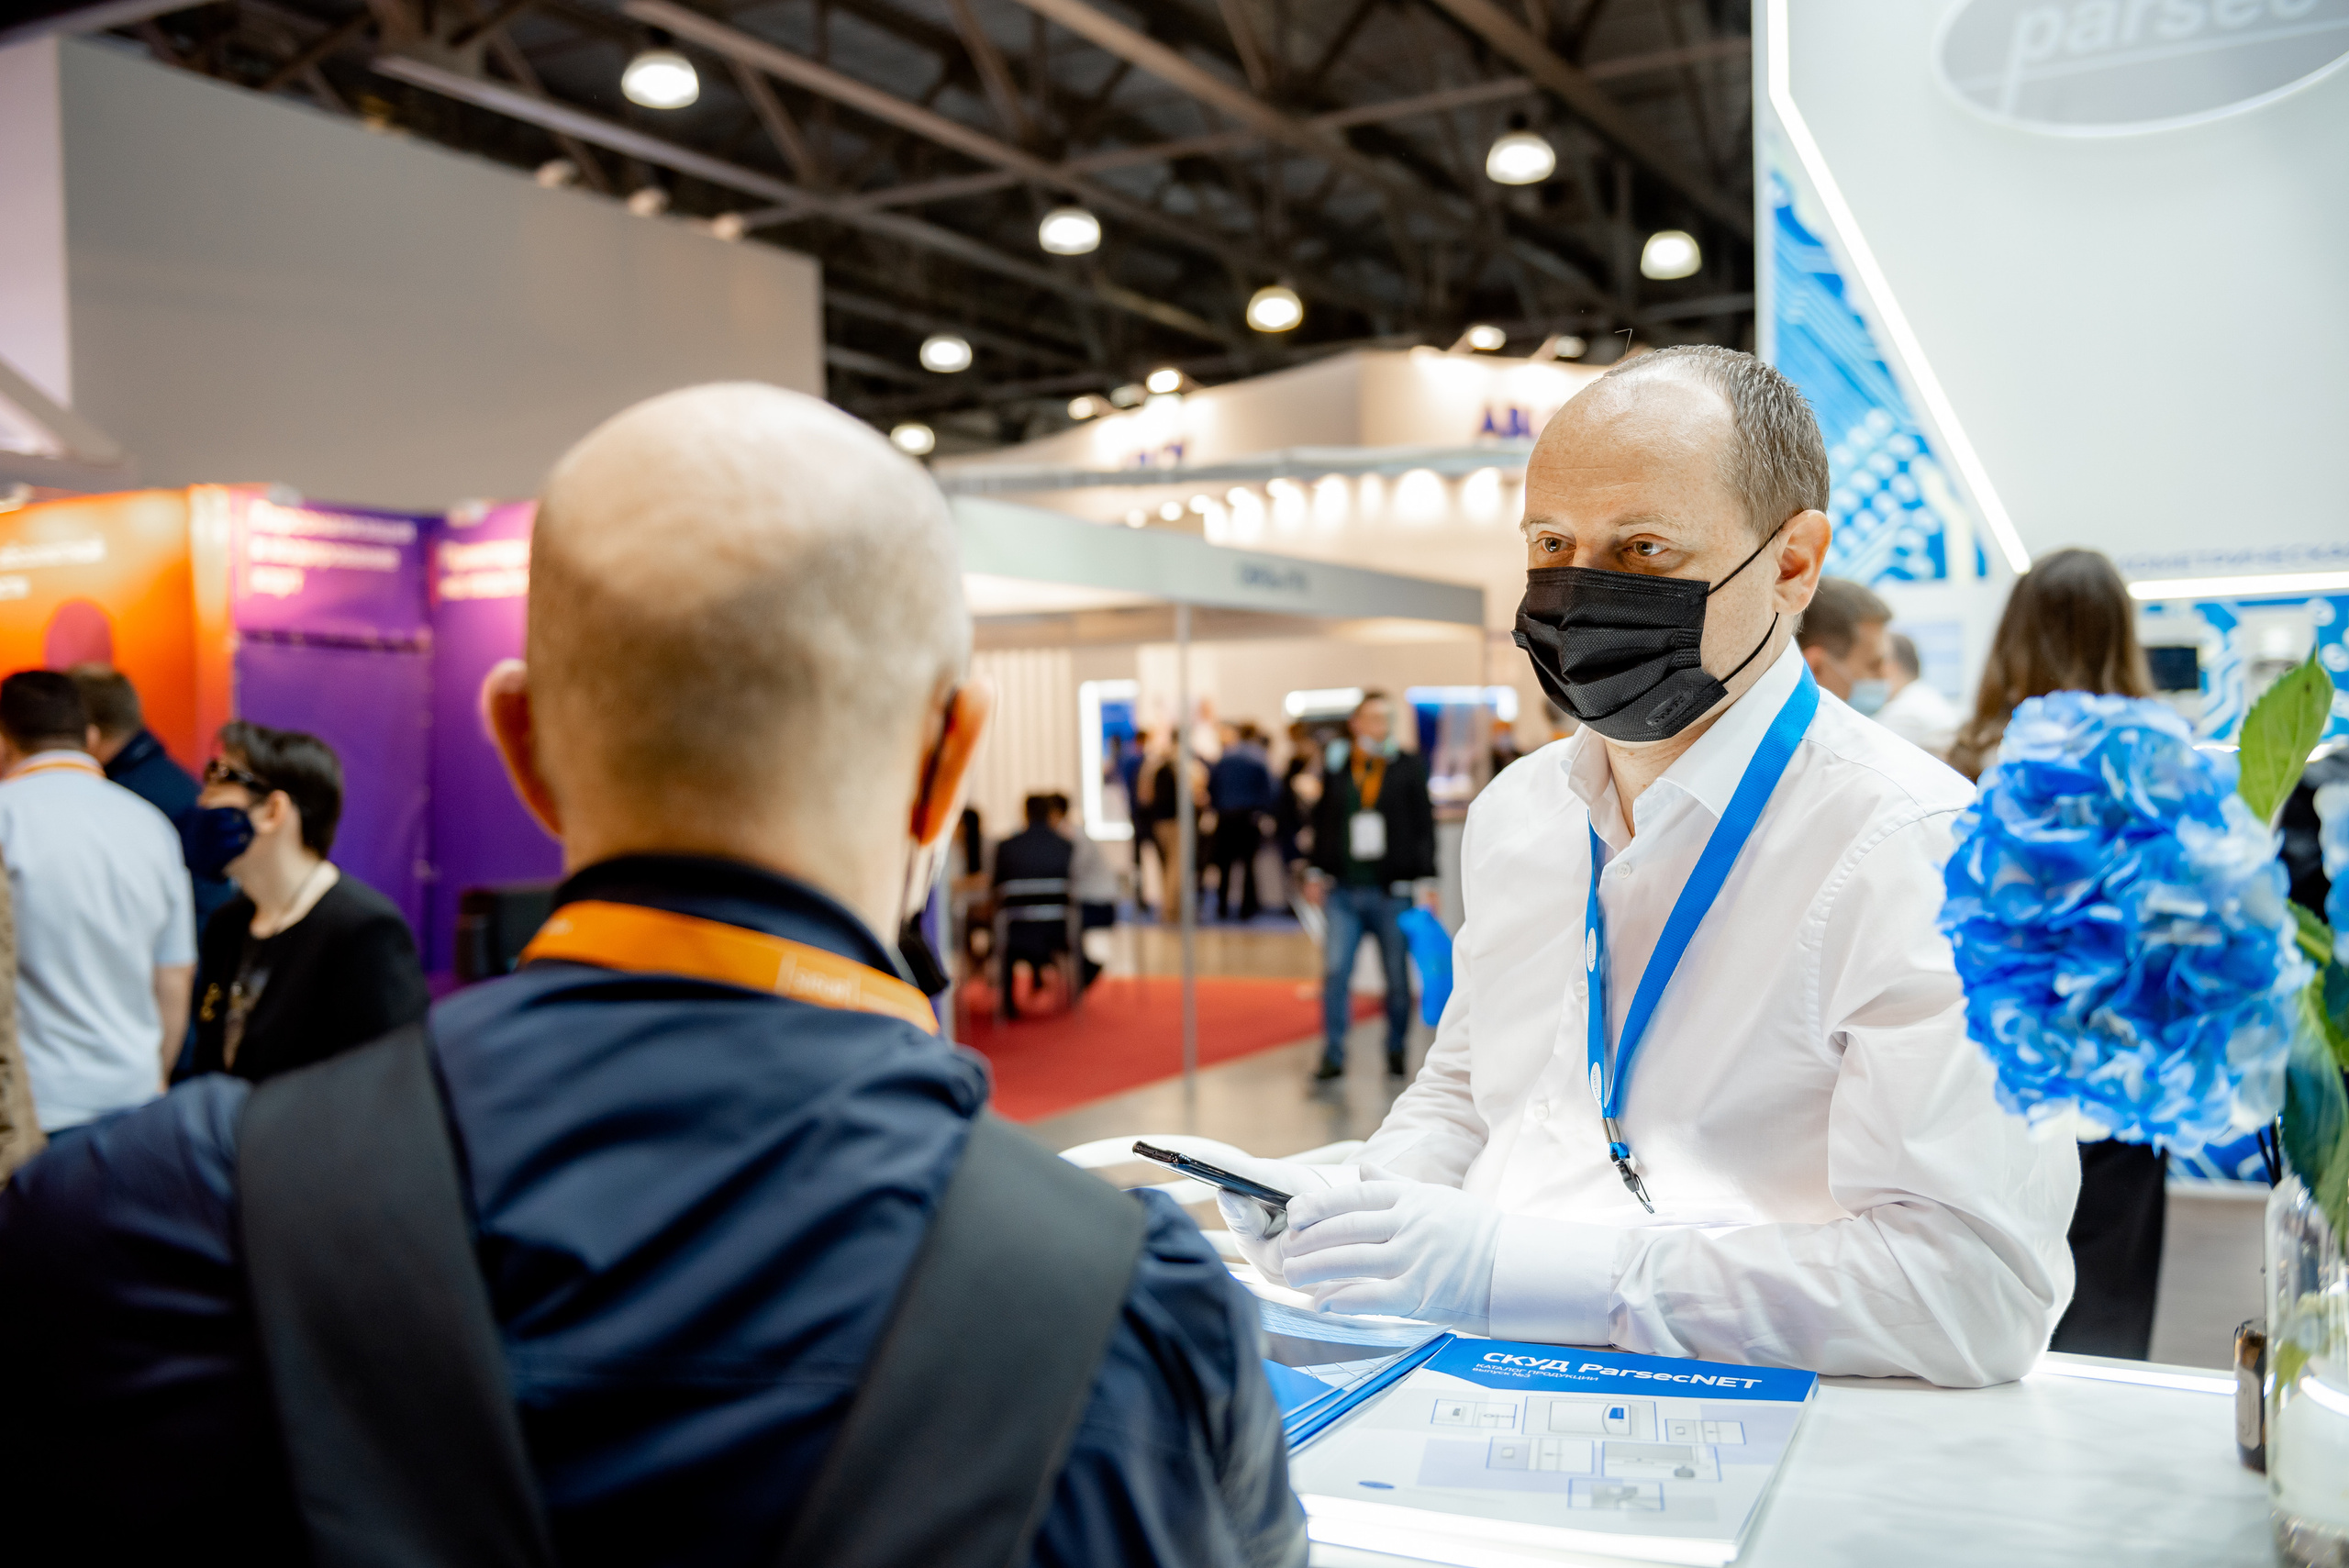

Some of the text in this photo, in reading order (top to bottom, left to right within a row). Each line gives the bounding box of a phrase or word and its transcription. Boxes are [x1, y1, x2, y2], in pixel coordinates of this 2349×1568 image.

[1475, 1362, 1599, 1382] КАТАЛОГ ПРОДУКЦИИ
[1483, 1352, 1763, 1389] СКУД ParsecNET
